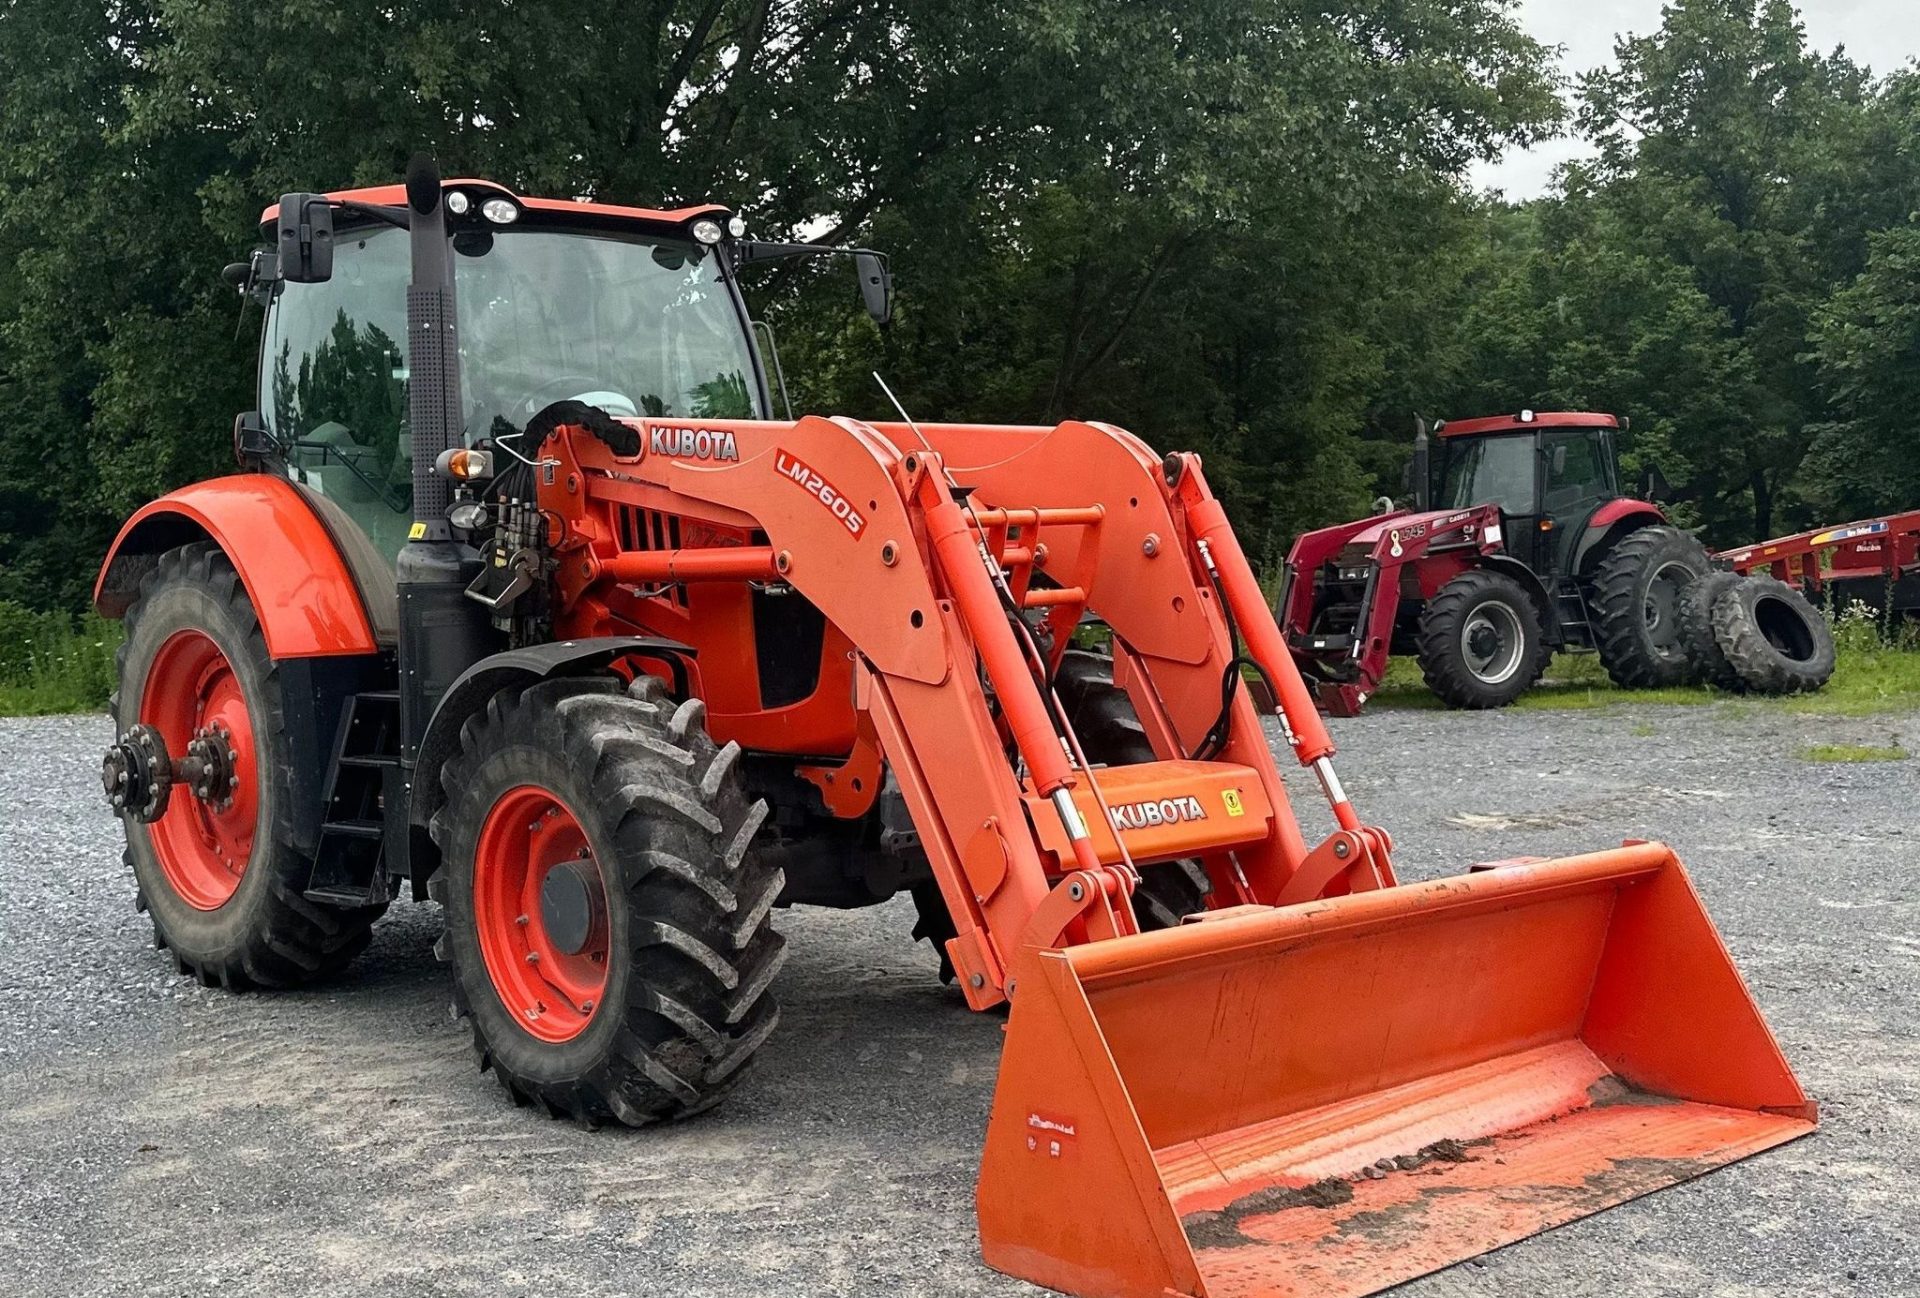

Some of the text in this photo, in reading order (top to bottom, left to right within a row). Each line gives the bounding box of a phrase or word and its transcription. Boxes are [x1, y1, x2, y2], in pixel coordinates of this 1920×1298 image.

[650, 425, 739, 461] KUBOTA
[776, 454, 864, 534] LM2605
[1109, 795, 1207, 831] KUBOTA
